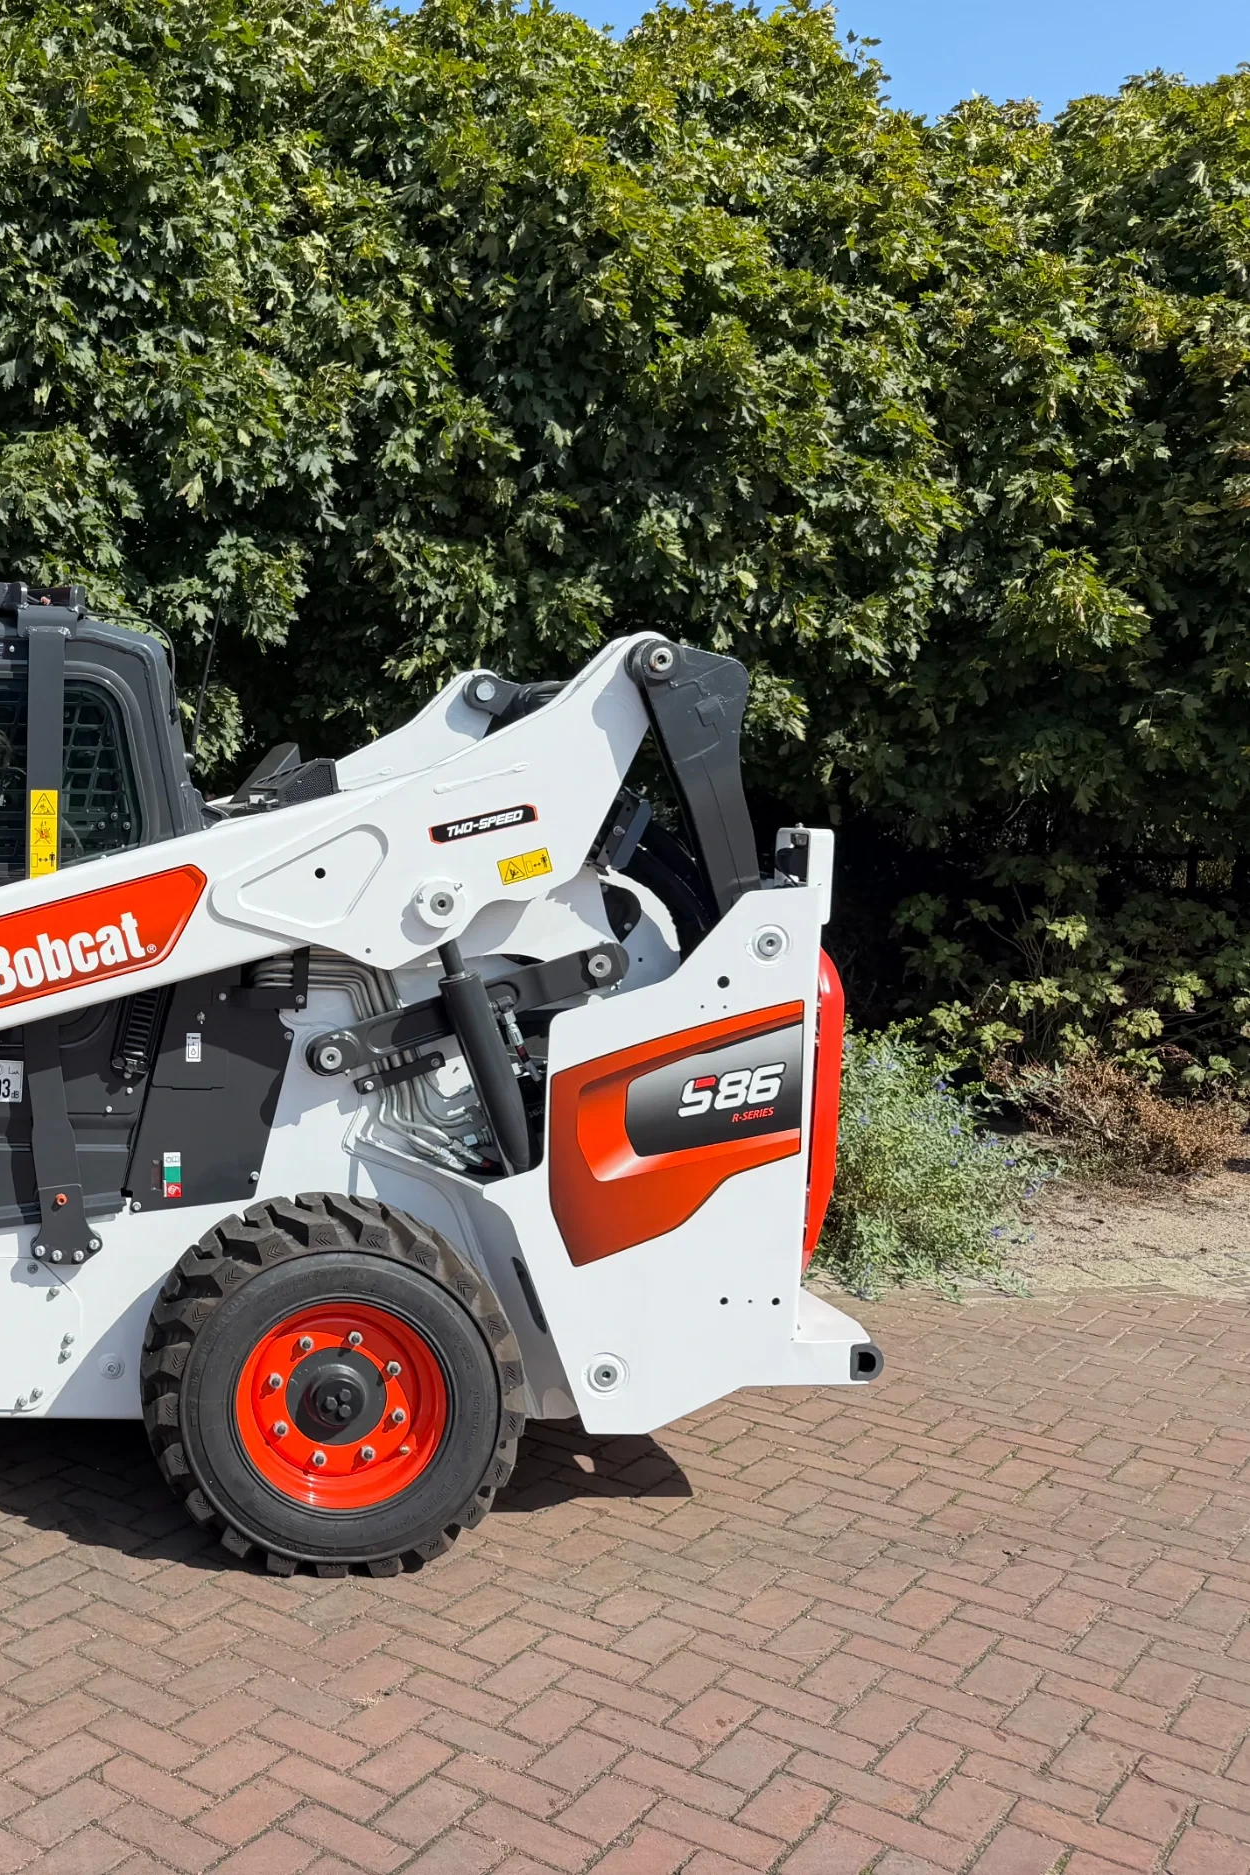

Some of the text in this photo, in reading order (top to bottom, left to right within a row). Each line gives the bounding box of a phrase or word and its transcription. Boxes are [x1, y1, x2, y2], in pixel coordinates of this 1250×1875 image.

[447, 809, 524, 838] TWO-SPEED
[677, 1062, 786, 1118] S86
[731, 1106, 775, 1123] R-SERIES
